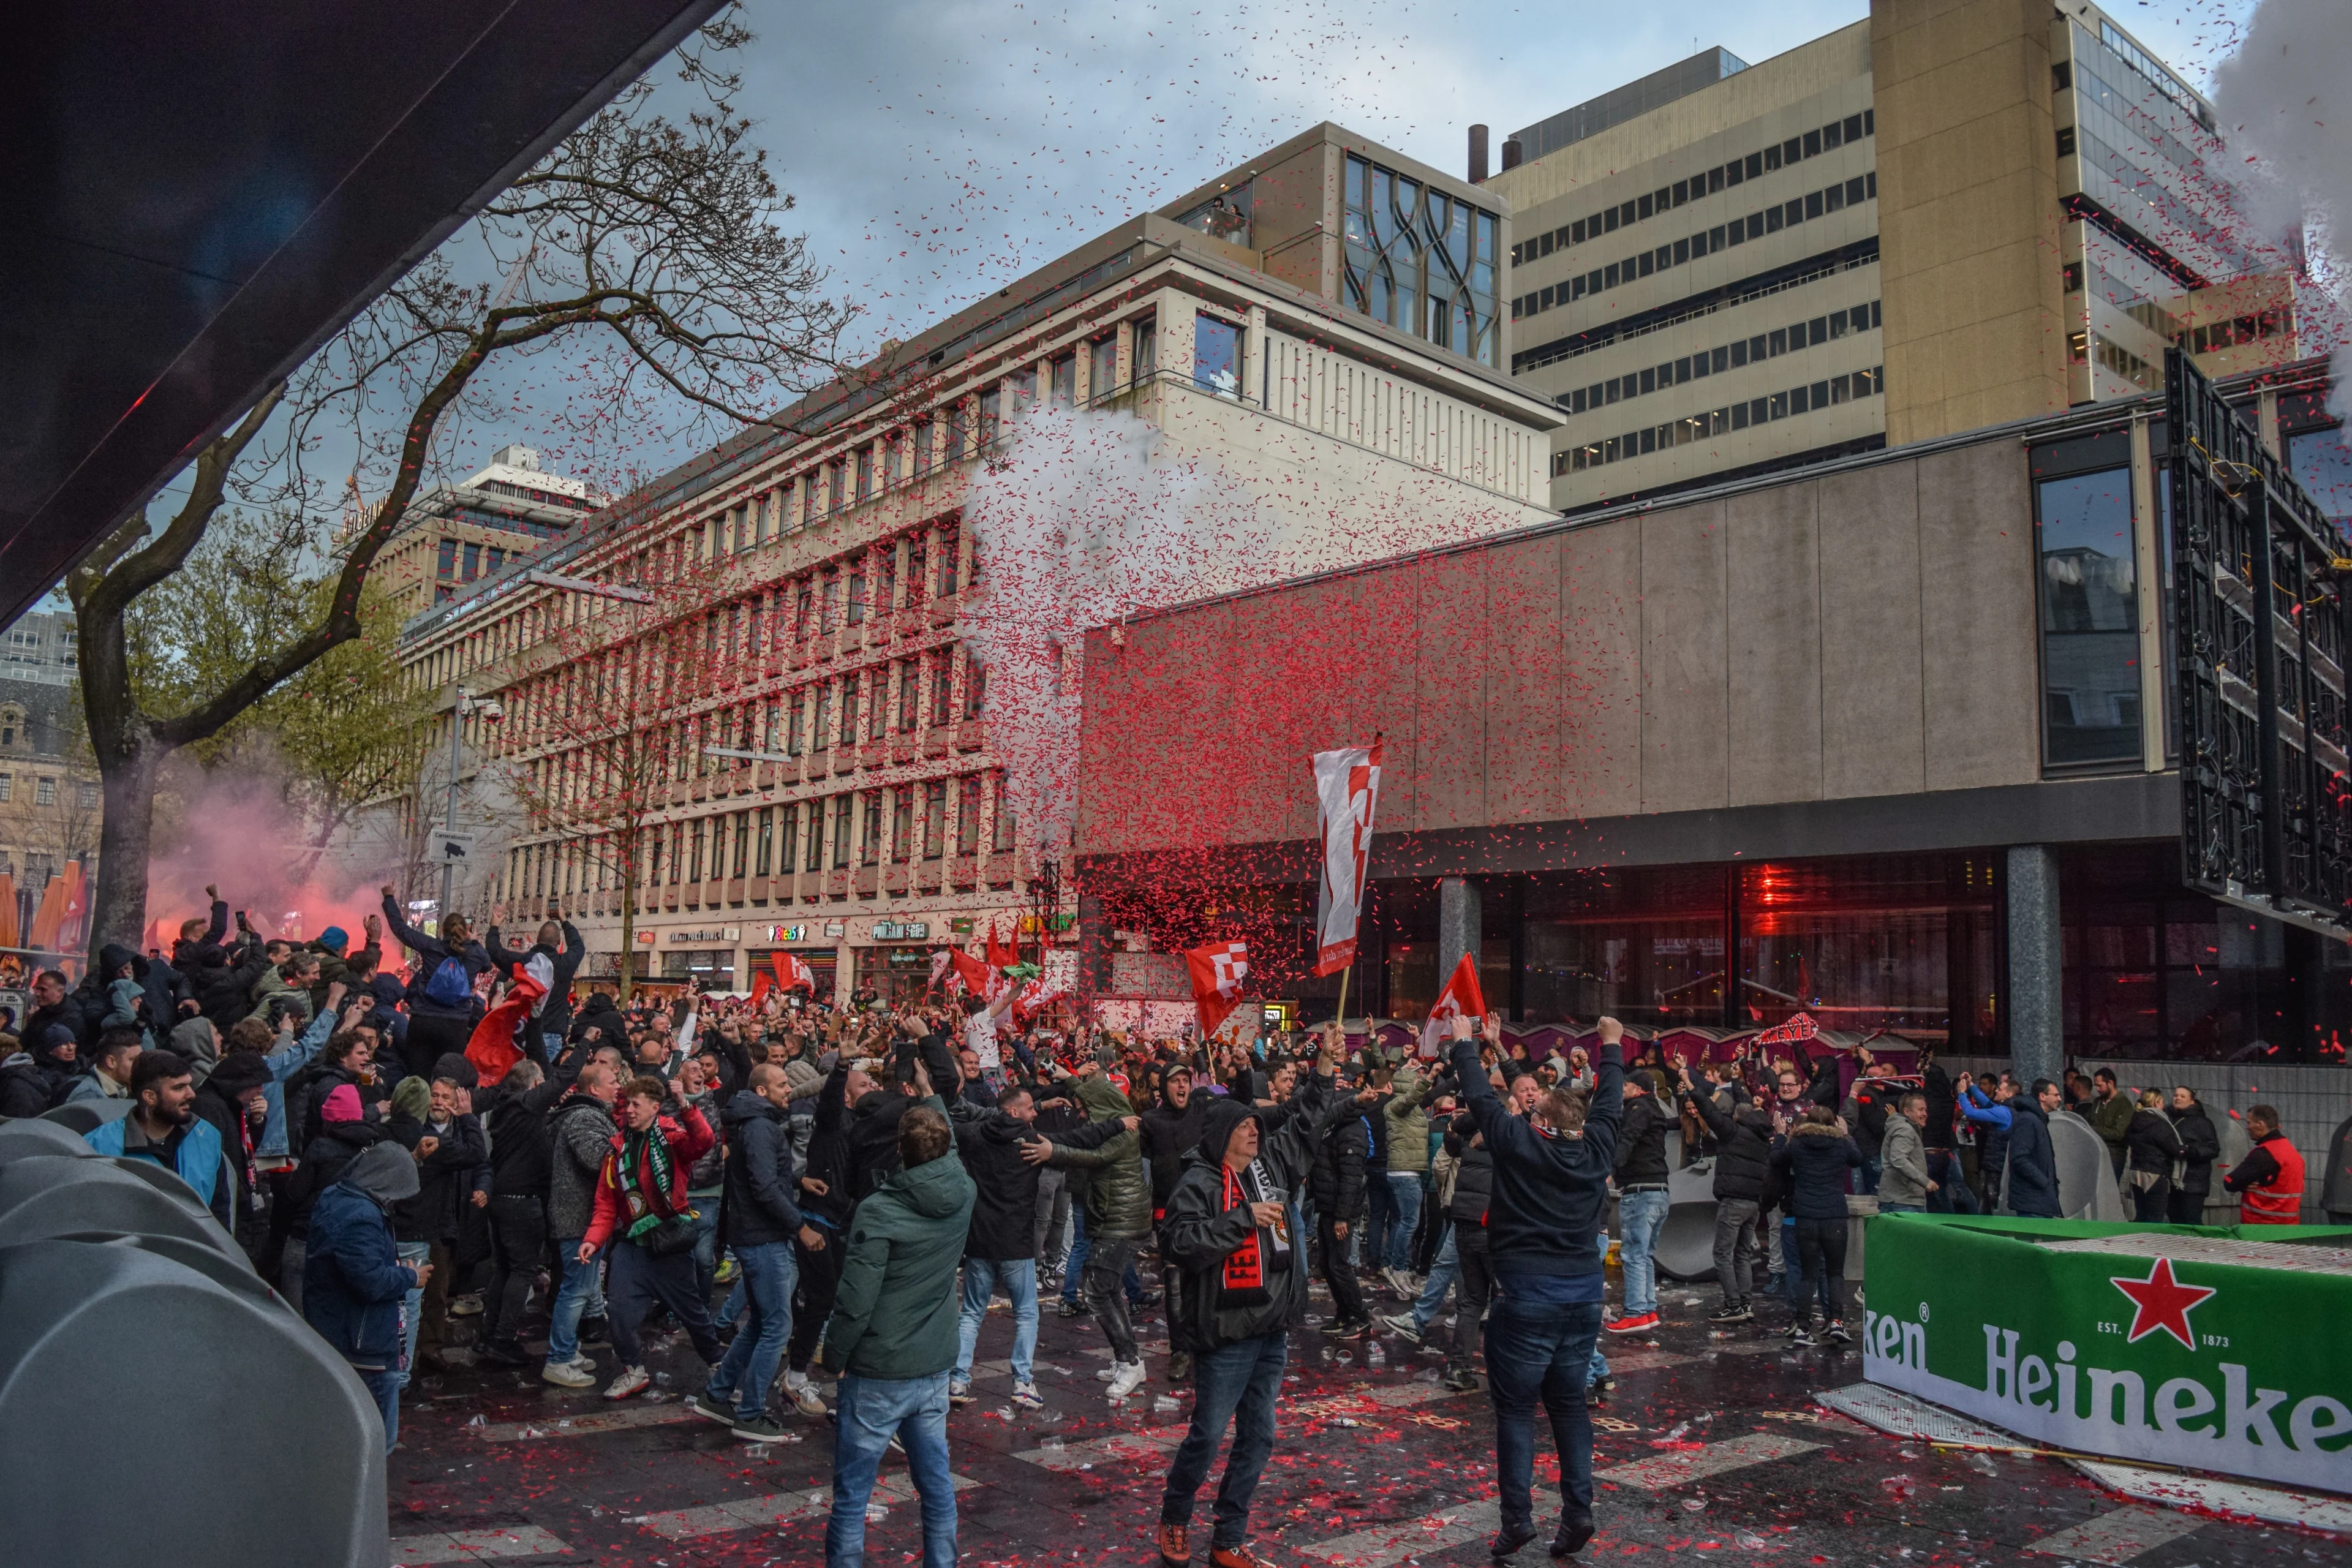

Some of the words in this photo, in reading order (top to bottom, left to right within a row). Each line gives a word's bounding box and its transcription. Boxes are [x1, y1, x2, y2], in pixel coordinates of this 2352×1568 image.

[435, 832, 472, 841] Cameratoezicht
[688, 932, 702, 941] POKE
[703, 932, 717, 941] BOWL
[776, 925, 796, 940] 8tea5
[873, 921, 903, 939] PUNJABI
[2097, 1321, 2122, 1335] EST.
[2202, 1334, 2230, 1348] 1873
[1983, 1324, 2352, 1452] Heineke
